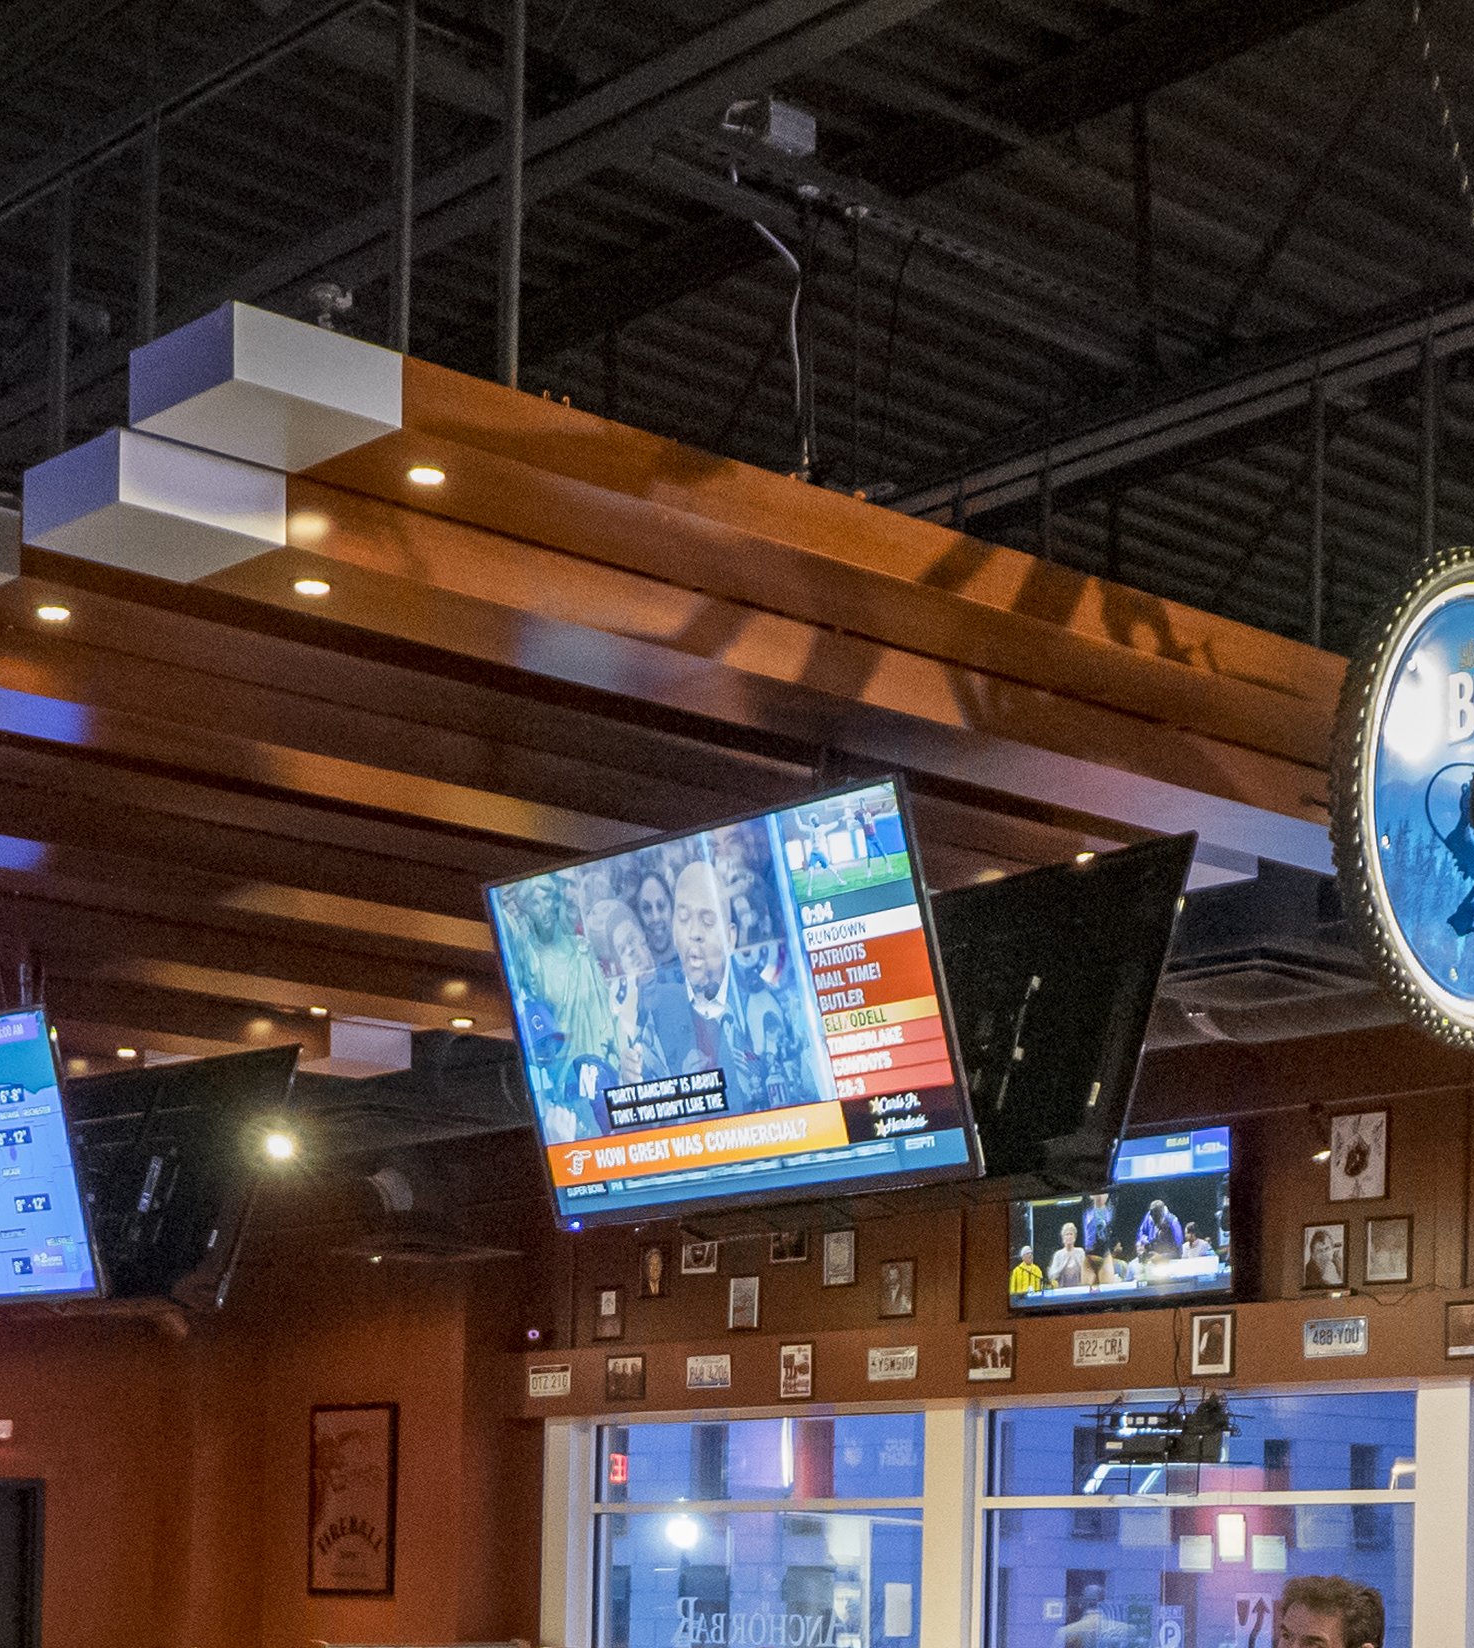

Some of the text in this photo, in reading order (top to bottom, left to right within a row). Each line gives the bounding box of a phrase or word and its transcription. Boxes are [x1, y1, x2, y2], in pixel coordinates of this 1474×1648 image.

[806, 921, 867, 945] RUNDOWN
[810, 943, 867, 968] PATRIOTS
[814, 962, 882, 990] MAIL TIME!
[819, 988, 865, 1012] BUTLER
[11, 1023, 25, 1037] AM
[594, 1146, 626, 1169] HOW
[628, 1138, 671, 1164] GREAT
[672, 1133, 704, 1154] WAS
[705, 1119, 808, 1150] COMMERCIAL?
